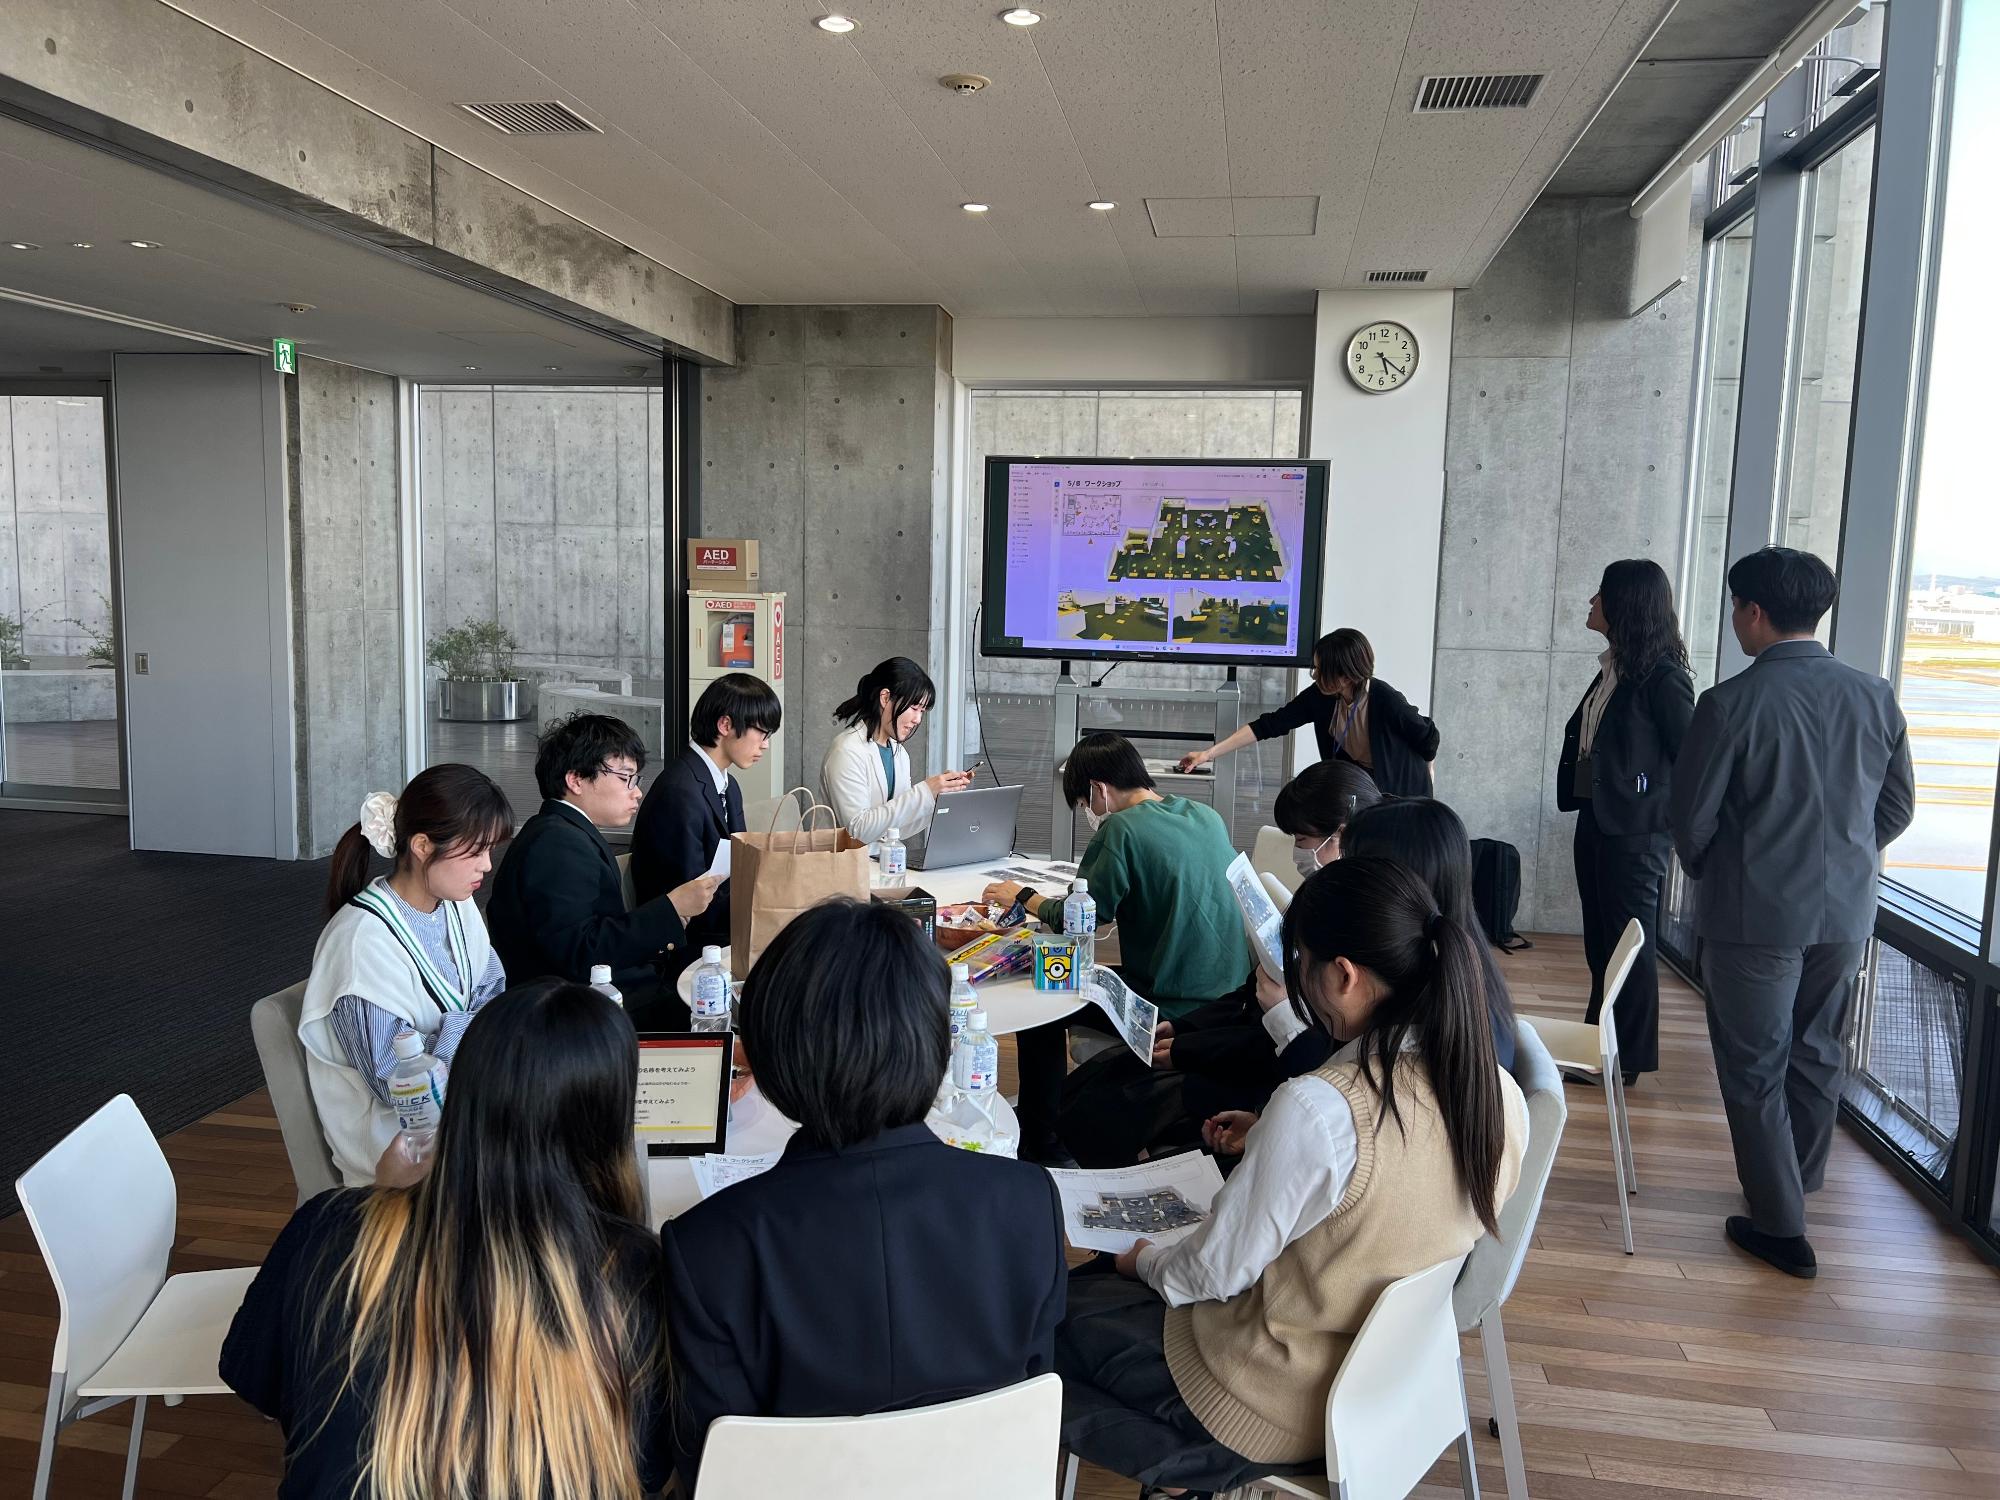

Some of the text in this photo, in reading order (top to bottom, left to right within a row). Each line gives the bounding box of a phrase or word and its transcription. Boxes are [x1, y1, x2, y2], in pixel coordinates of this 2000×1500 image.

[1380, 329, 1389, 337] 12
[1360, 341, 1368, 349] 10
[1402, 341, 1407, 349] 2
[1405, 354, 1410, 362] 3
[1359, 365, 1364, 373] 8
[1400, 366, 1406, 374] 4
[1368, 374, 1373, 382] 7
[1379, 377, 1384, 385] 6
[1391, 374, 1397, 382] 5
[703, 549, 729, 560] AED
